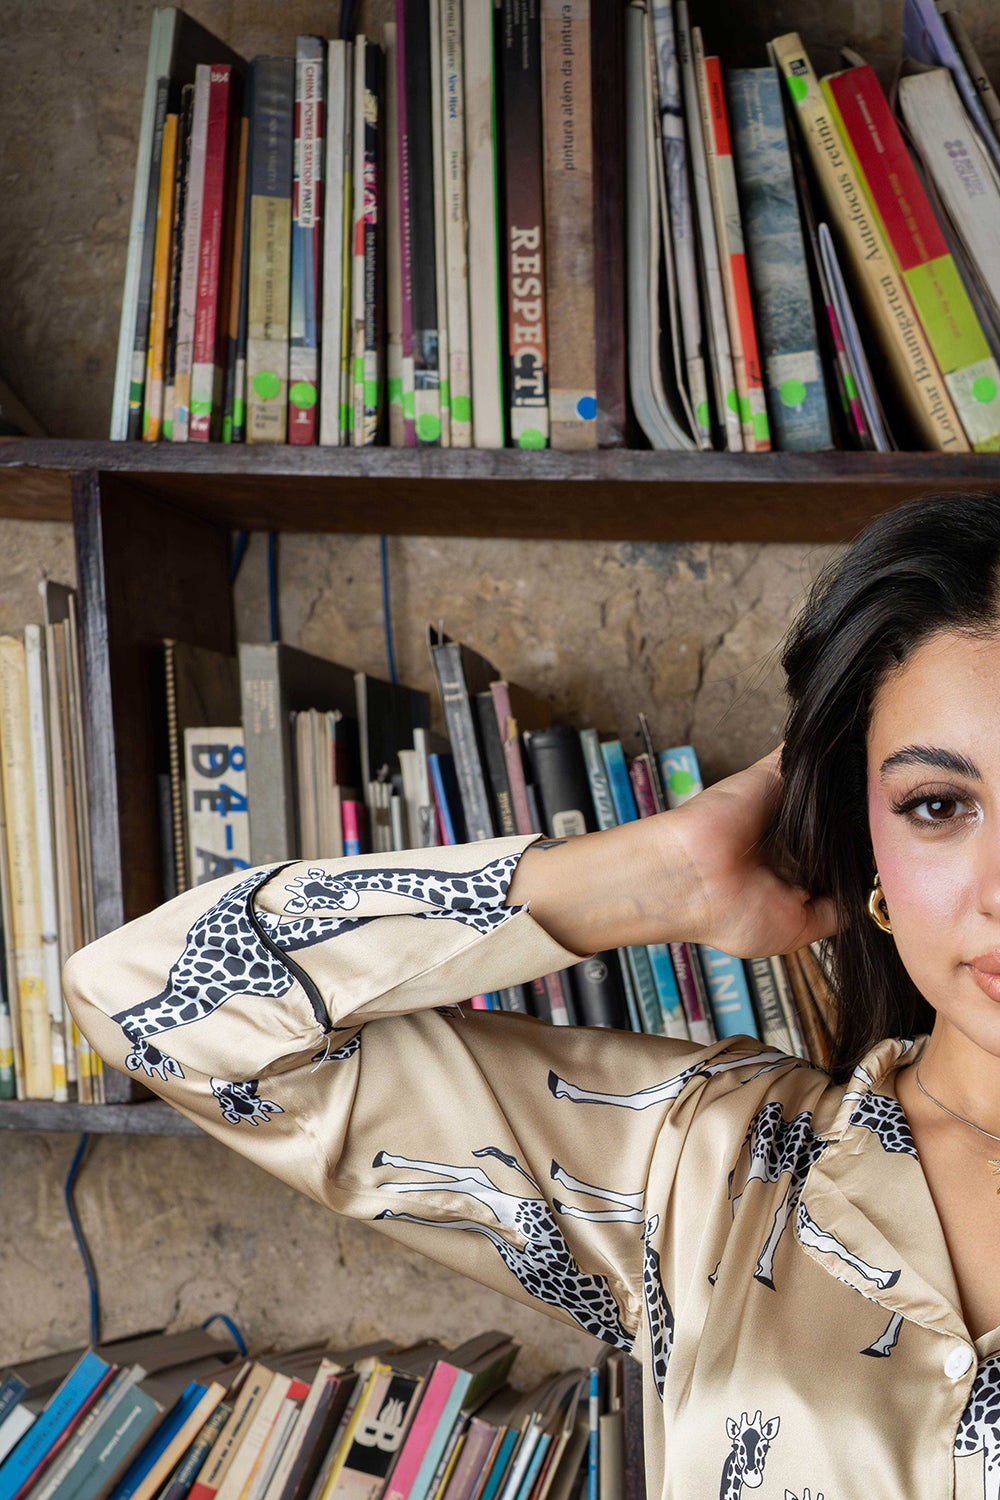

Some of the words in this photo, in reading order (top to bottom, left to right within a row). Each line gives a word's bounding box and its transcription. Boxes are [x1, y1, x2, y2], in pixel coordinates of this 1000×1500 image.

[559, 3, 575, 56] pintura
[303, 65, 315, 100] CHINA
[560, 58, 573, 77] da
[559, 79, 574, 116] além
[302, 101, 314, 141] POWER
[806, 113, 844, 171] retina
[300, 142, 313, 186] STATION
[558, 118, 576, 171] pintura
[300, 187, 312, 215] PART
[829, 169, 884, 267] Autofocus
[365, 230, 376, 245] the
[365, 245, 376, 270] khalid
[365, 271, 375, 302] shoman
[365, 302, 376, 346] foundation
[507, 225, 547, 406] RESPECT!
[873, 271, 936, 383] Baumgarten
[918, 381, 959, 448] Lothar
